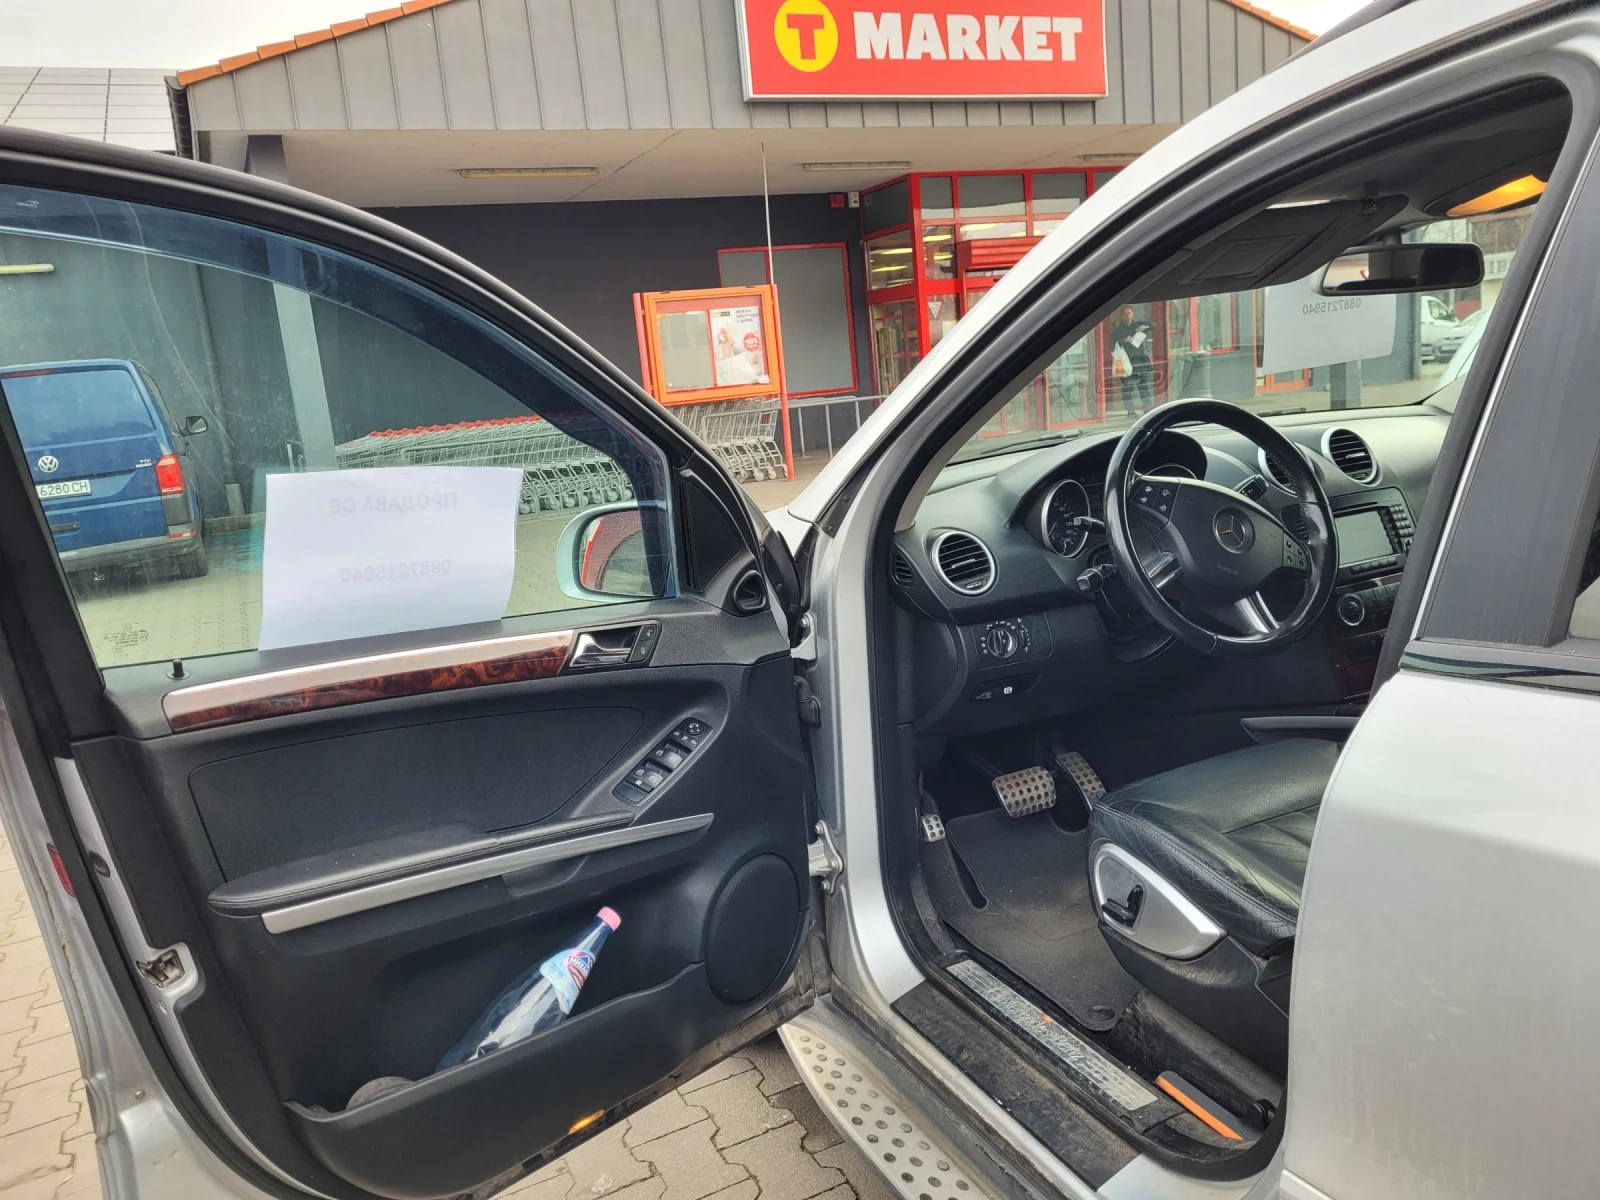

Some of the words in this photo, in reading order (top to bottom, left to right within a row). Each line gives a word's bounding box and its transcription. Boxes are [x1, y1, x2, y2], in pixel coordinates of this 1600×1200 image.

[786, 13, 825, 60] T
[853, 11, 1083, 62] MARKET
[40, 483, 70, 497] 6280
[71, 481, 89, 494] CH
